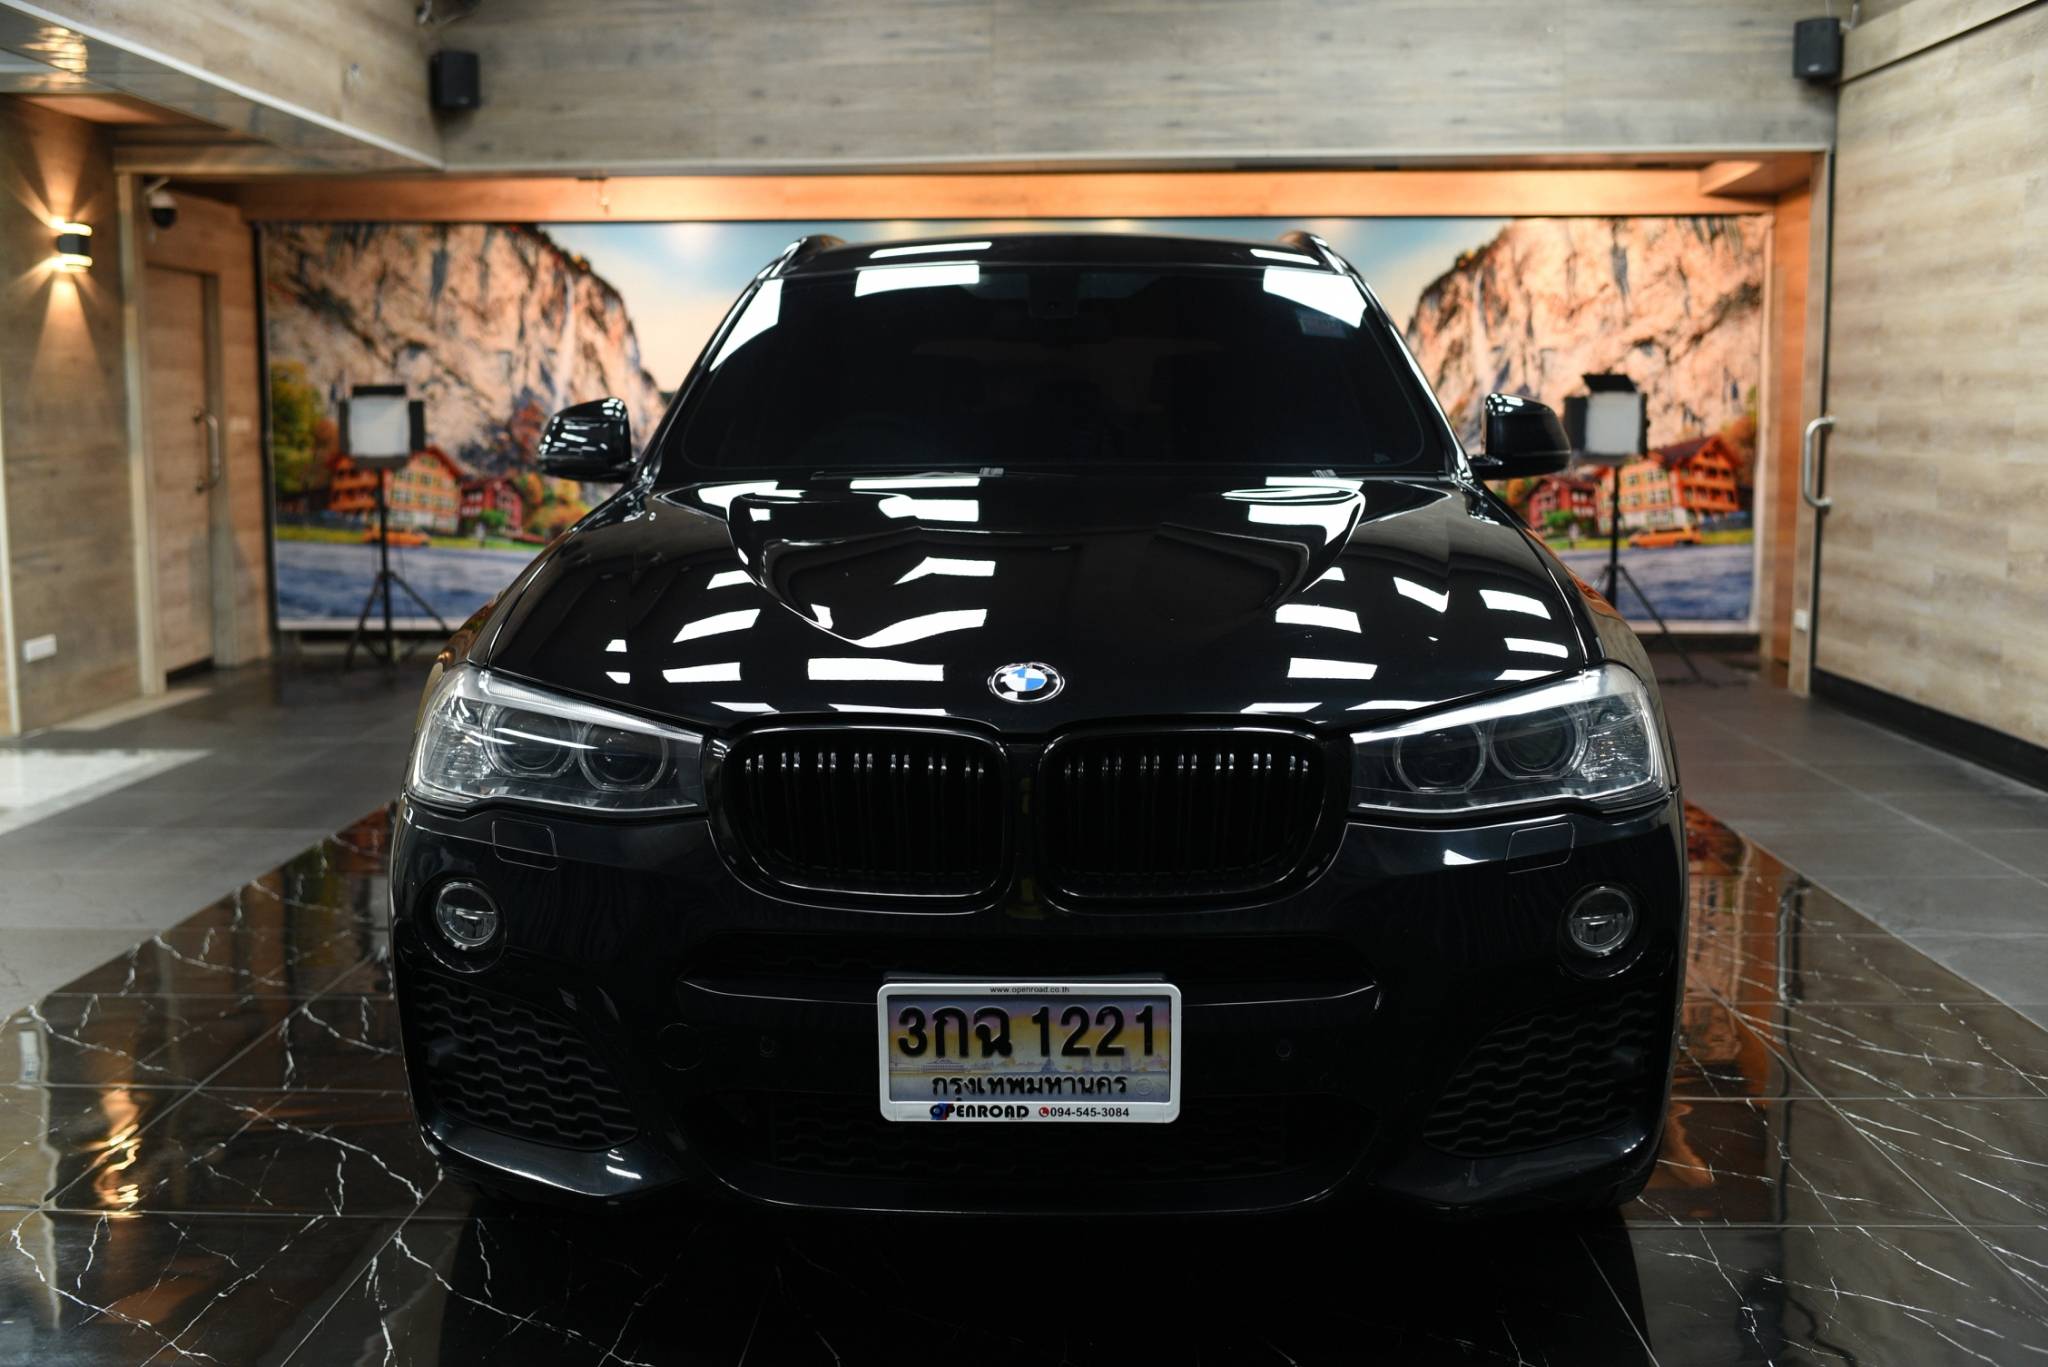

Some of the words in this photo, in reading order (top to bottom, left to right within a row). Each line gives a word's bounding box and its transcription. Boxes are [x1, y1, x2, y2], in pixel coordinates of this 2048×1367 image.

[990, 986, 1070, 994] www.openroad.co.th
[898, 1005, 1013, 1058] 3กฉ
[1032, 1005, 1154, 1057] 1221
[932, 1076, 1128, 1101] กรุงเทพมหานคร
[929, 1103, 1030, 1119] OPENROAD
[1049, 1106, 1130, 1118] 094-545-3084
